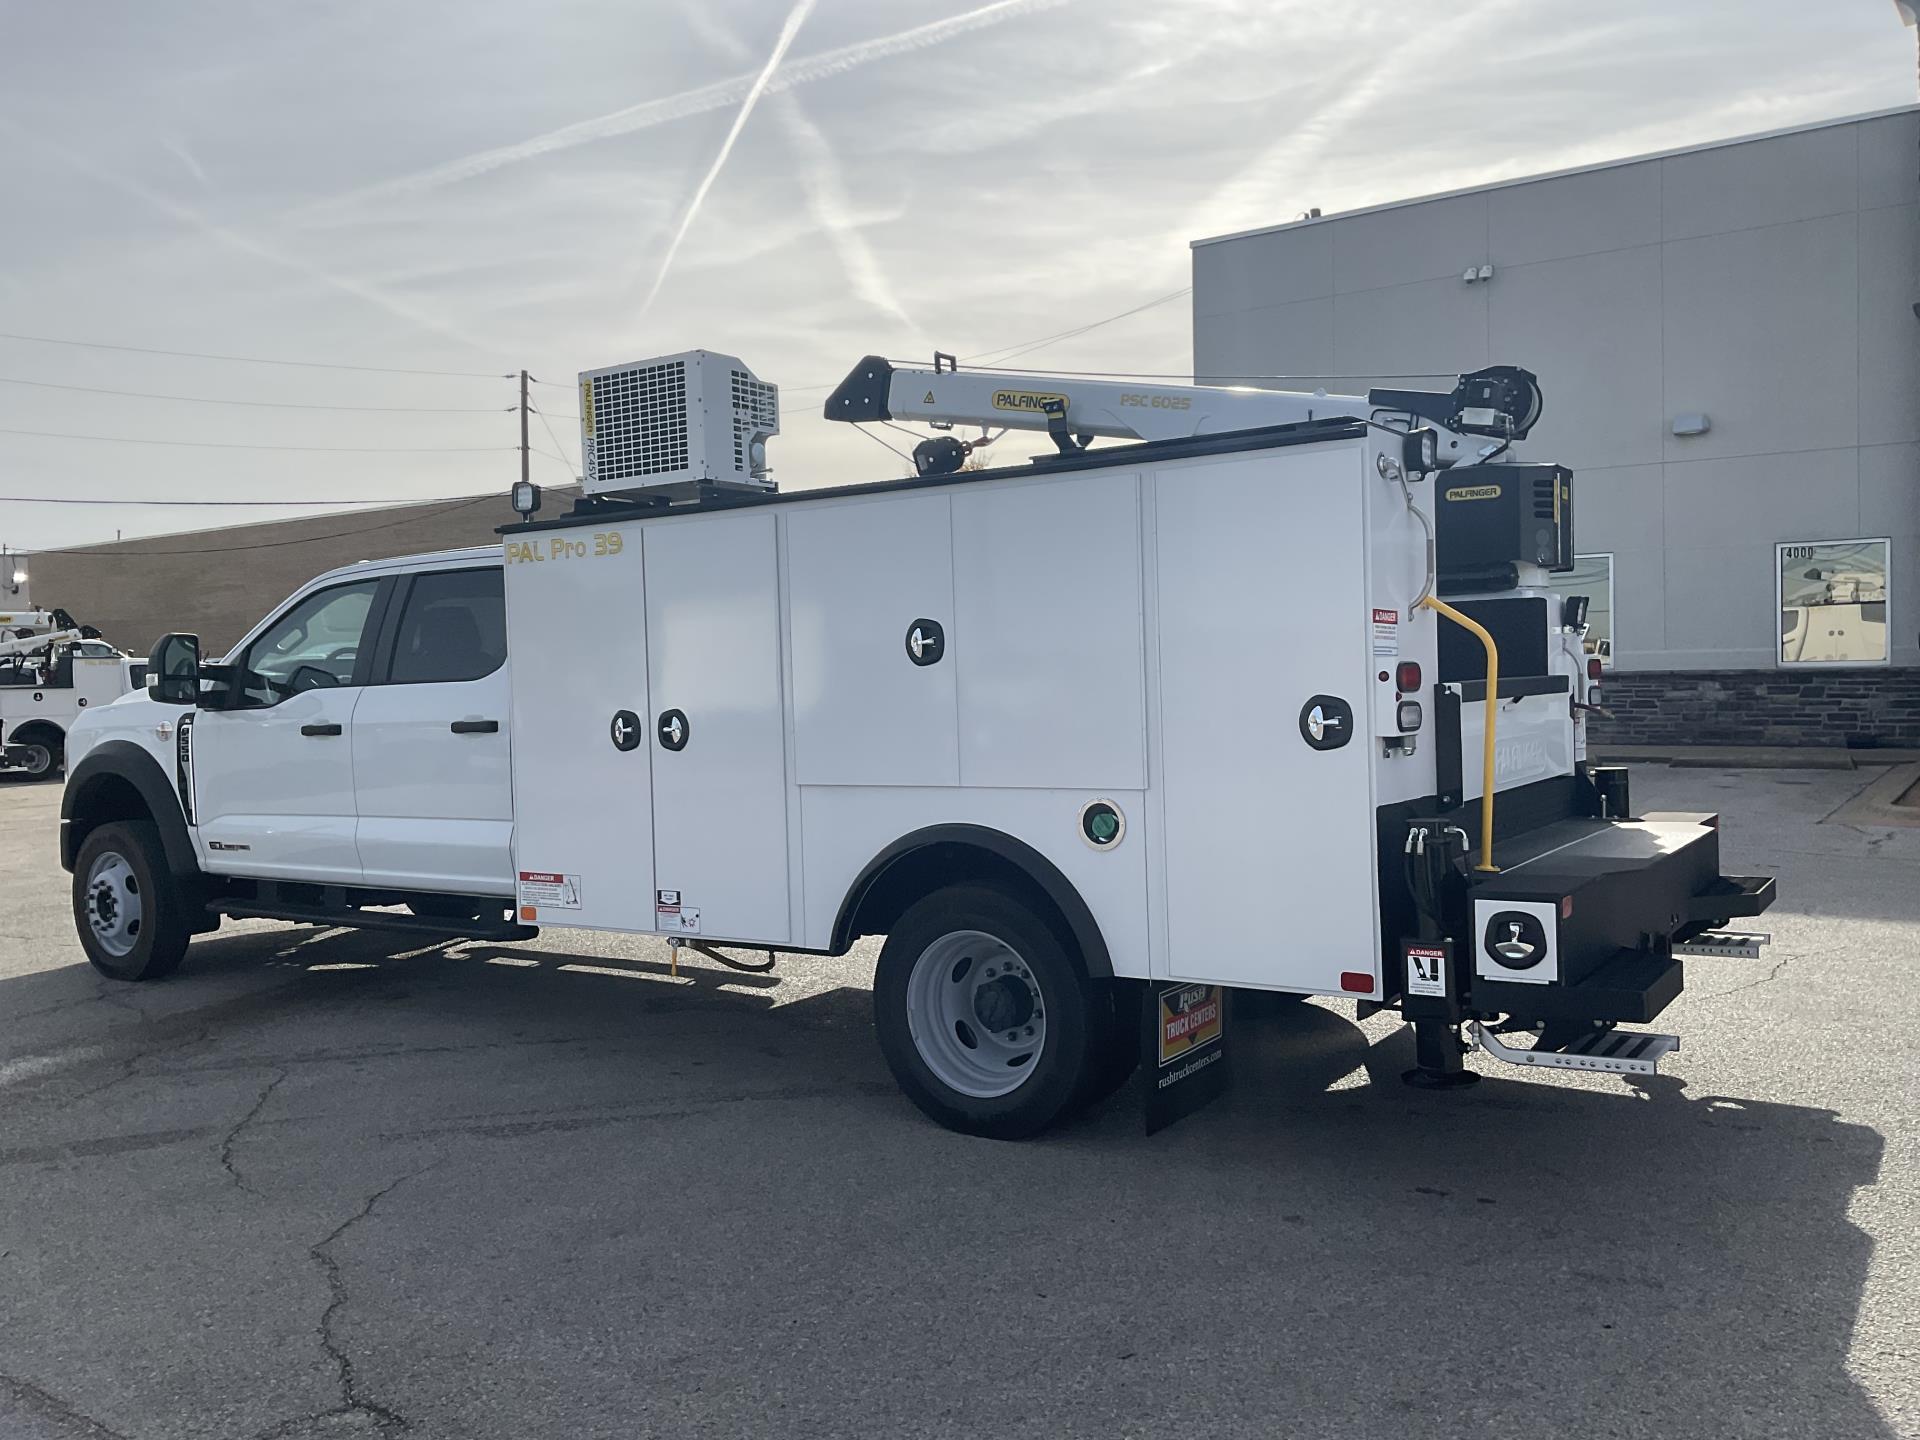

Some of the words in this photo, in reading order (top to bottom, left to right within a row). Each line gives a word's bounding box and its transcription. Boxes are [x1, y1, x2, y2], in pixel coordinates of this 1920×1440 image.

[997, 393, 1057, 409] PALFING
[1120, 393, 1148, 407] PSC
[1151, 395, 1192, 410] 6025
[587, 438, 597, 480] PRC45V
[1450, 487, 1497, 499] PALFINGER
[507, 541, 544, 564] PAL
[550, 538, 586, 560] Pro
[594, 532, 623, 556] 39
[1786, 547, 1813, 560] 4000
[1379, 610, 1396, 622] DANGER
[533, 874, 555, 882] DANGER
[1416, 949, 1443, 957] DANGER
[1166, 1015, 1189, 1040] TRUCK
[1190, 1002, 1217, 1030] CENTERS
[1158, 1049, 1222, 1089] rushtruckcenters.com
